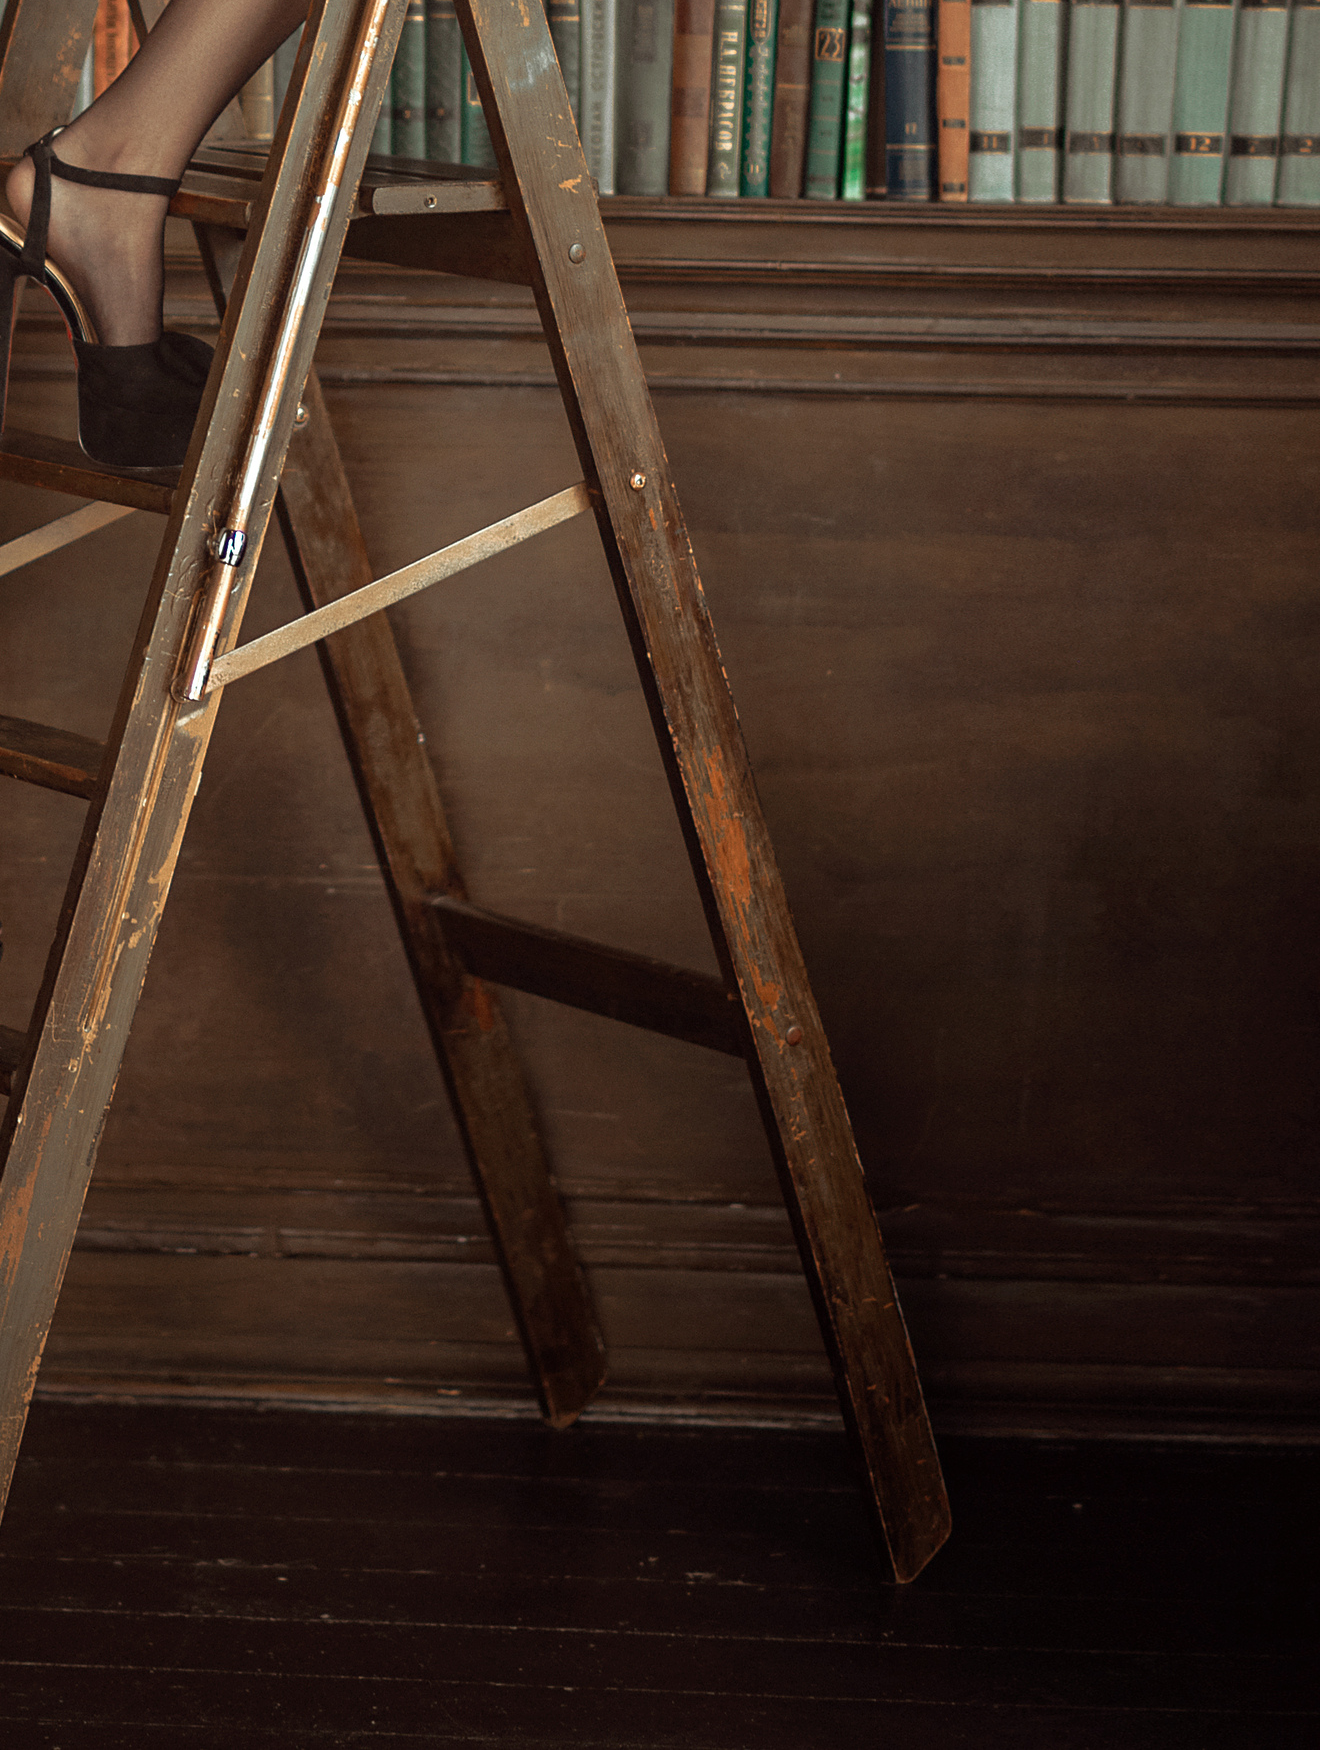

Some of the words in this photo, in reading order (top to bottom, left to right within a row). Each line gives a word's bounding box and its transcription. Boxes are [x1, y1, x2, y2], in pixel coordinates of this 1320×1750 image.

[819, 32, 842, 58] 23
[716, 64, 737, 152] НЕКРАСОВ
[1189, 137, 1211, 151] 12
